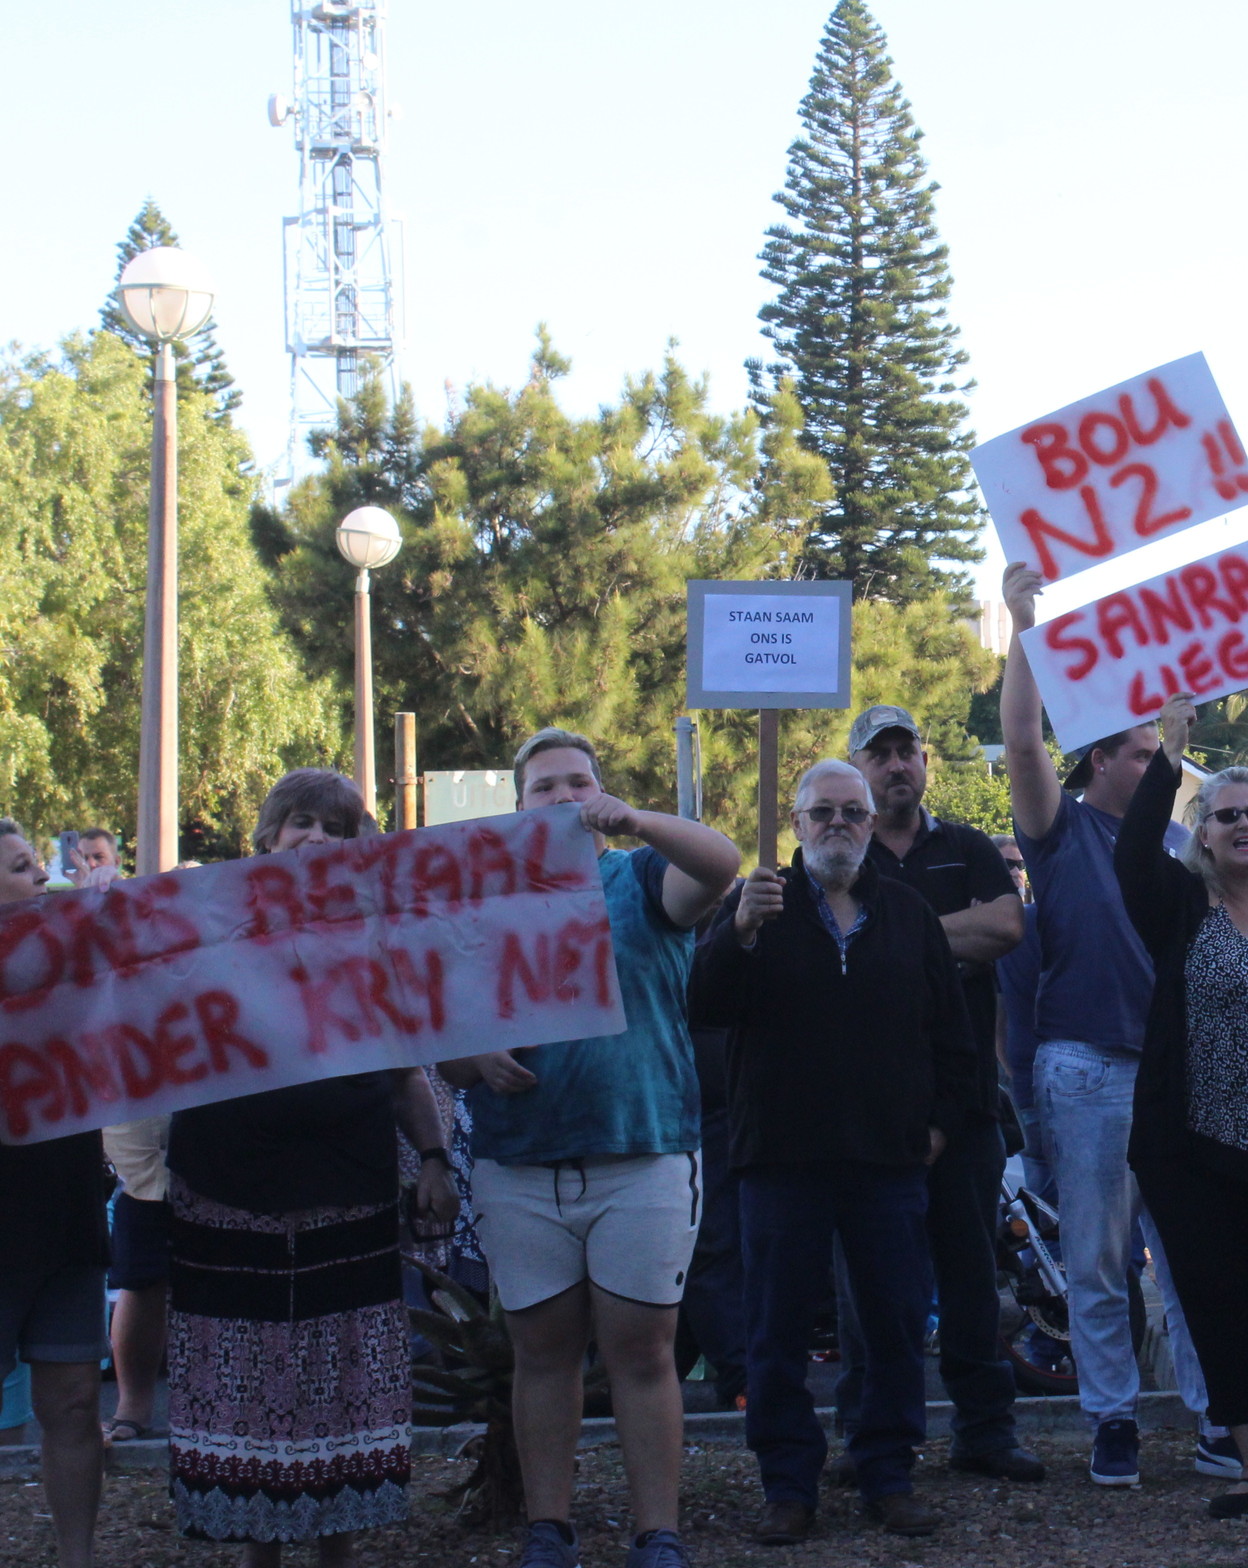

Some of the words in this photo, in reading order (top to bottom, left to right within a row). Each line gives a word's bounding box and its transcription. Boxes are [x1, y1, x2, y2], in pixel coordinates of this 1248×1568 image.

[1020, 377, 1192, 490] BOU
[1020, 463, 1193, 580] N2
[729, 611, 771, 623] STAAN
[775, 612, 814, 623] SAAM
[745, 653, 797, 664] GATVOL
[750, 633, 777, 644] ONS
[781, 634, 792, 644] IS
[243, 820, 588, 943] BETAAL
[0, 990, 268, 1137] ANDER
